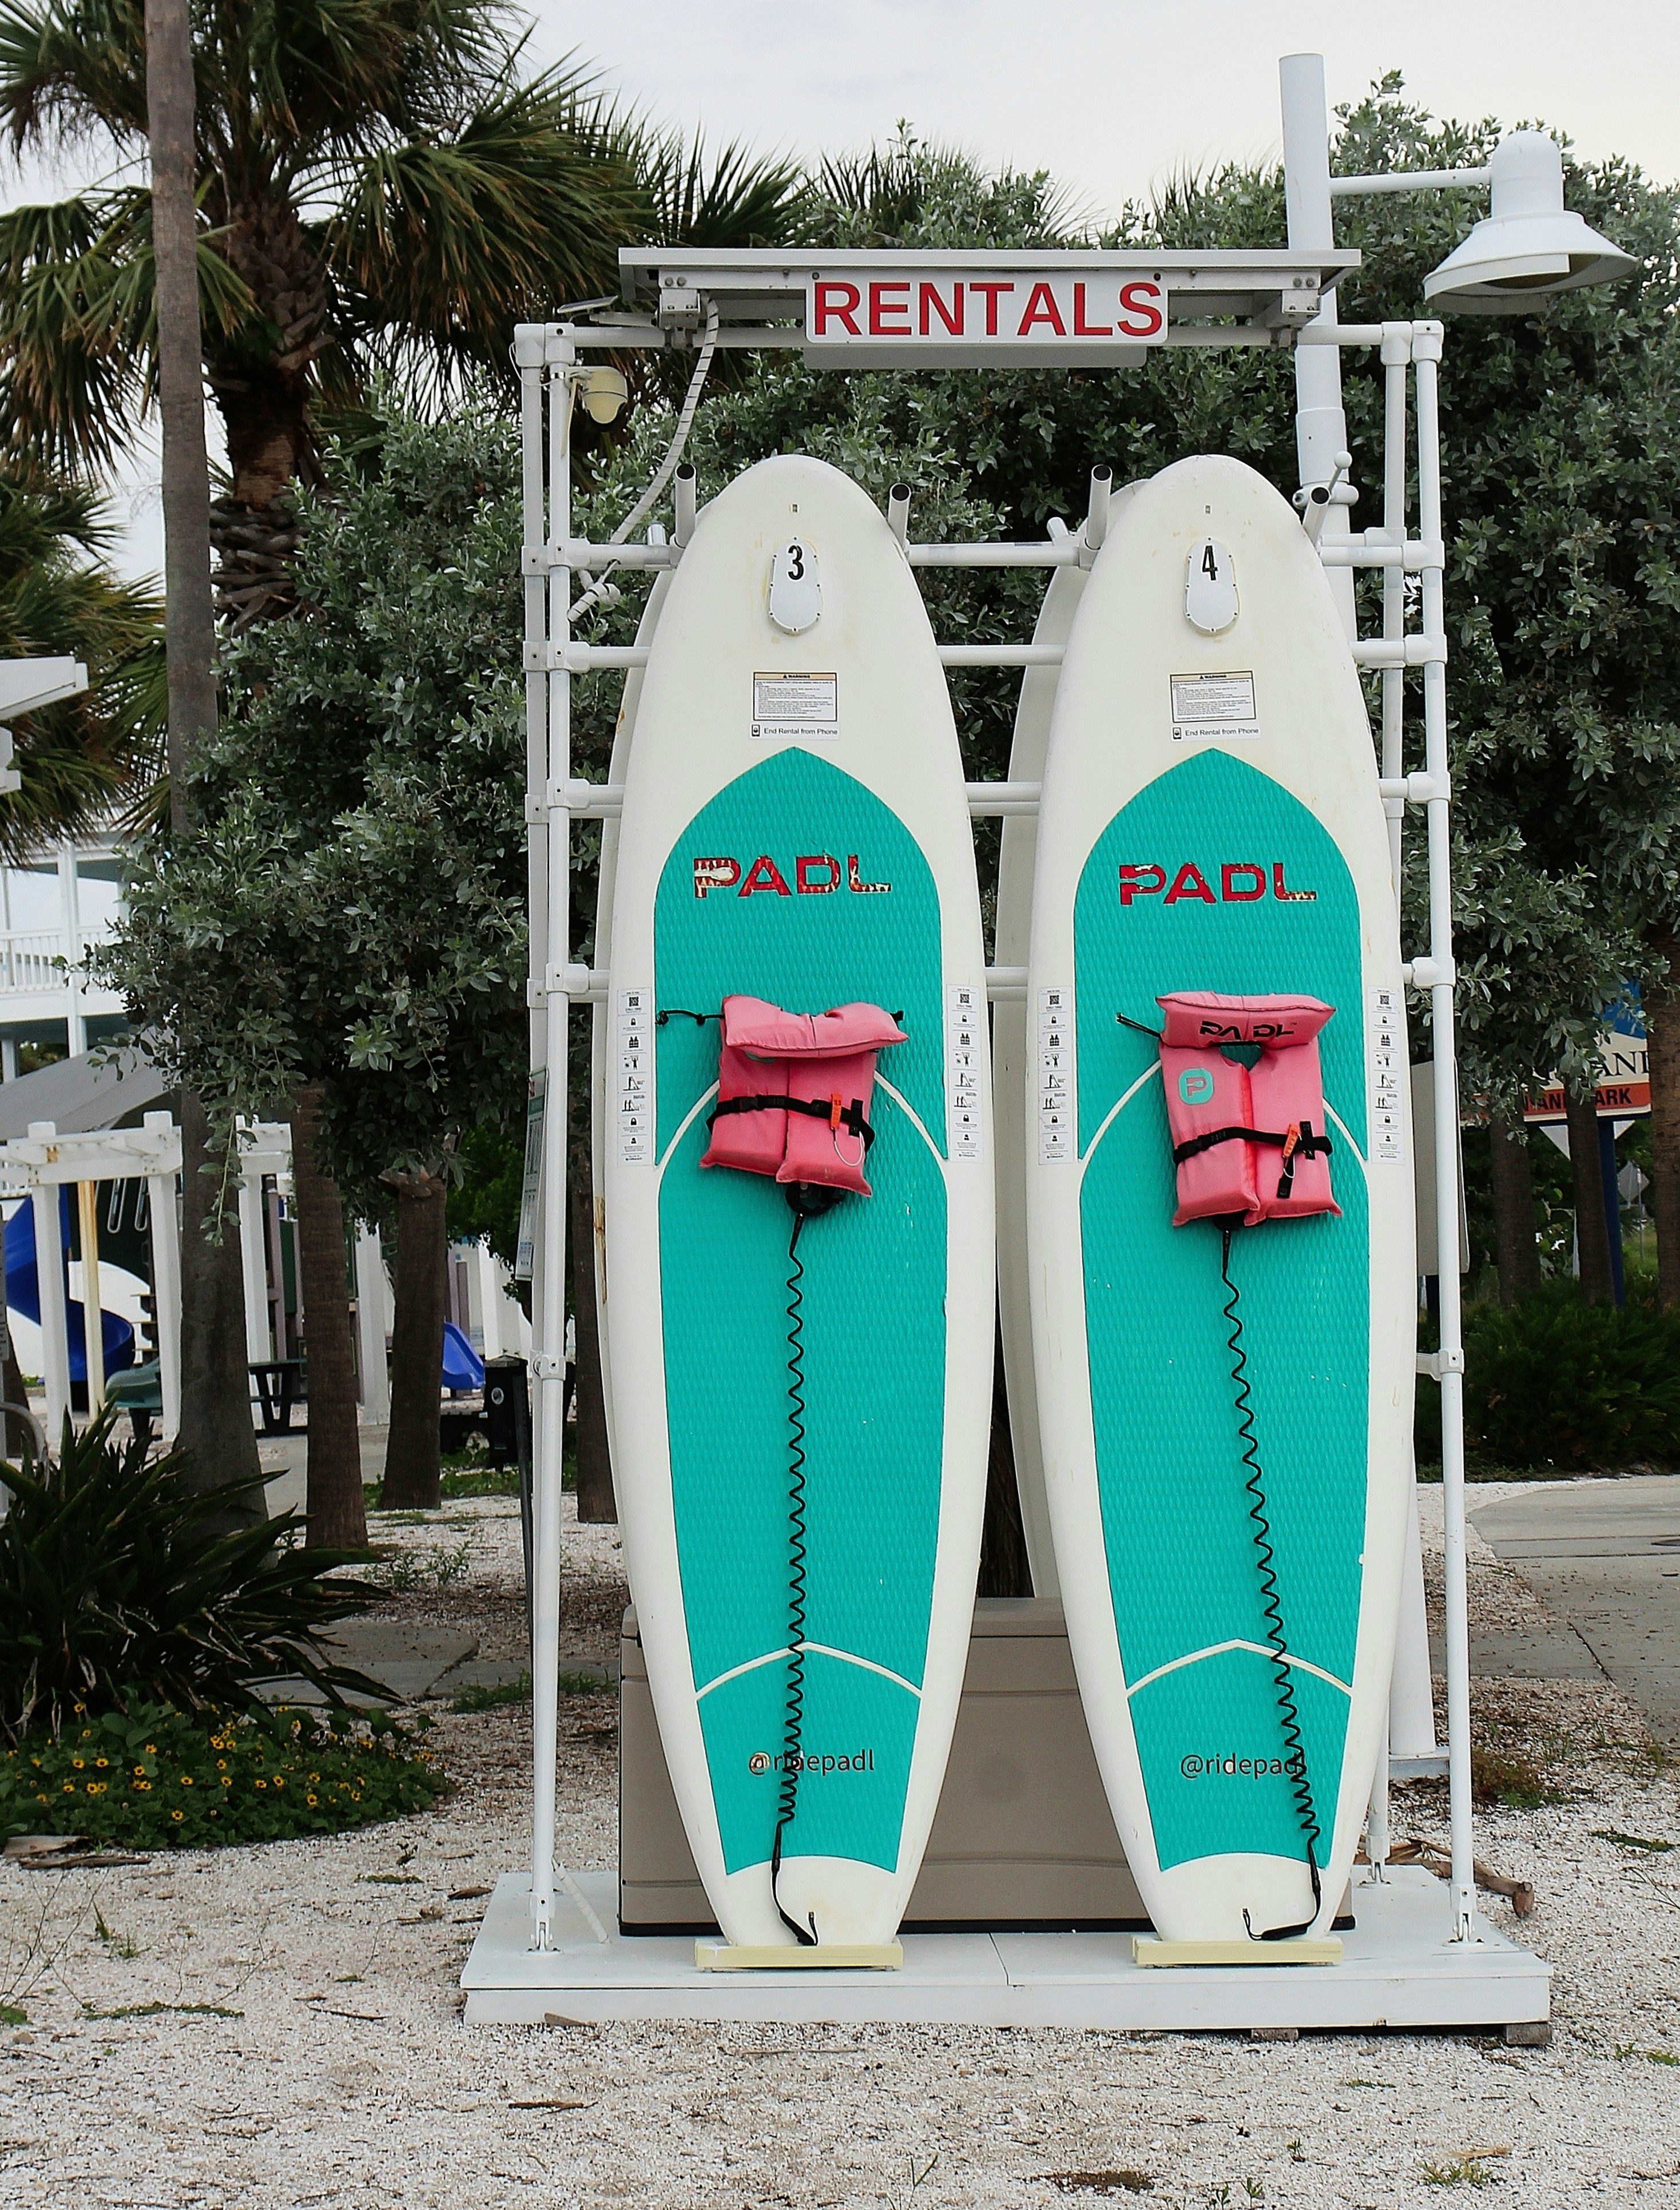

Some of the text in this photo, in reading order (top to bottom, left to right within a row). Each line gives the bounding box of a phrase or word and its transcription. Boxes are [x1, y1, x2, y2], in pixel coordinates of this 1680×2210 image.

[814, 281, 1163, 336] RENTALS
[787, 544, 805, 581] 3
[1202, 545, 1219, 581] 4
[764, 726, 838, 735] End Rental from Phone
[1185, 726, 1259, 737] End Rental from Phone
[693, 854, 892, 898] PADL
[1119, 862, 1317, 905] PADL
